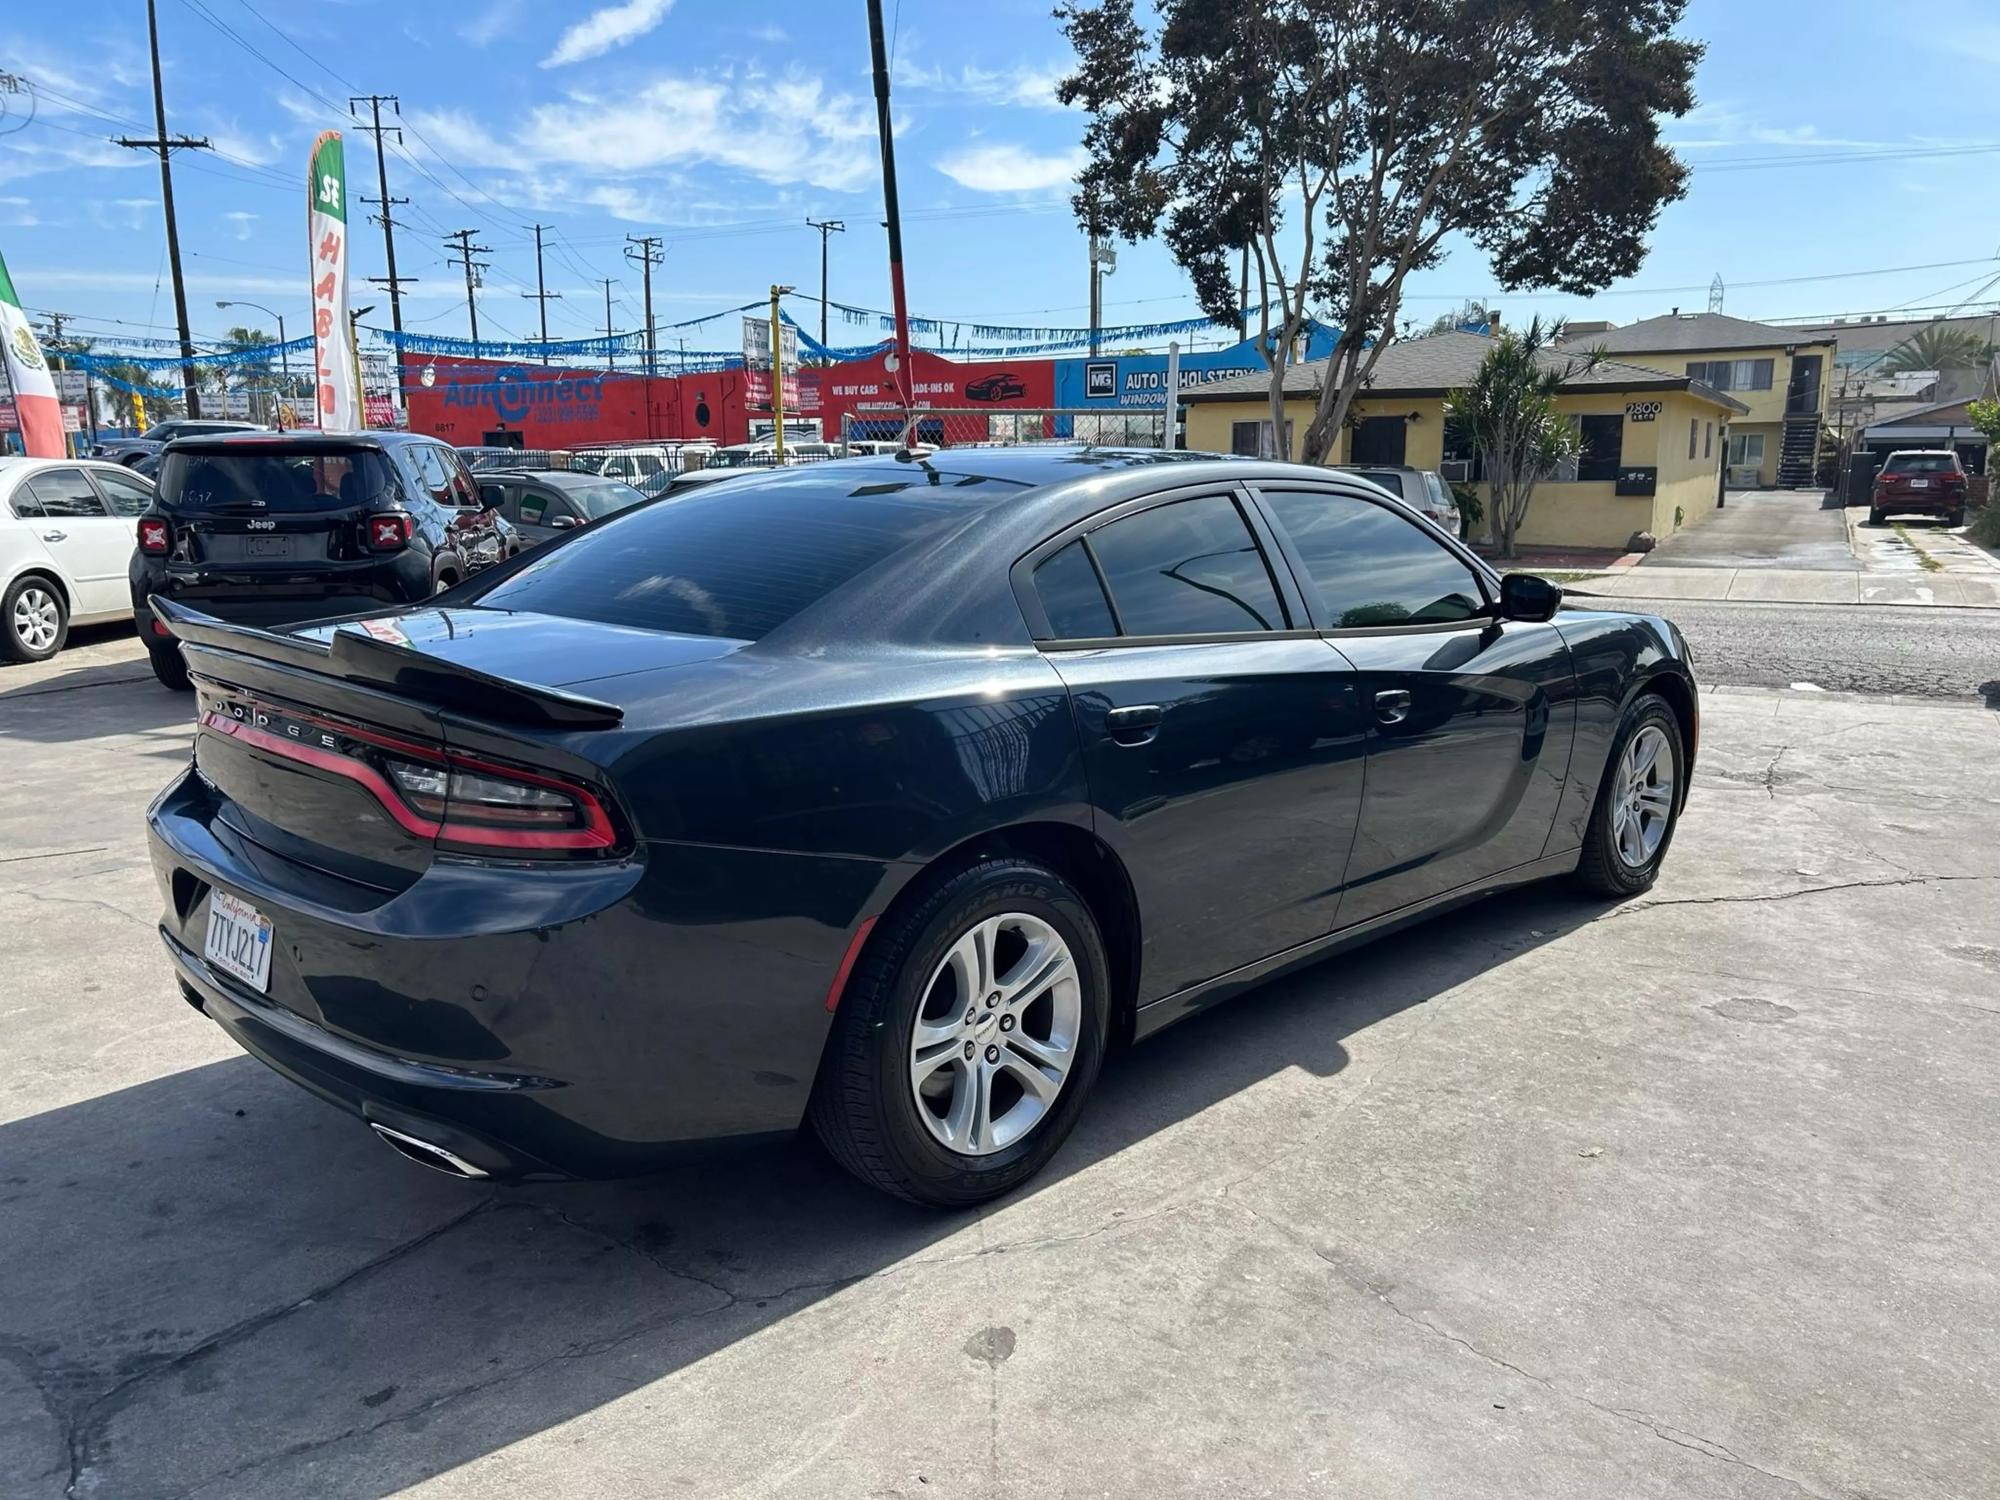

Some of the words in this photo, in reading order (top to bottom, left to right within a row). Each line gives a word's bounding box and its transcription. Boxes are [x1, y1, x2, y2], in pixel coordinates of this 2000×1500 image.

[319, 174, 340, 210] SE
[1091, 374, 1112, 387] MG
[1126, 372, 1158, 390] AUTO
[1162, 368, 1255, 389] UHOLSTERY
[832, 385, 844, 396] WE
[845, 385, 859, 395] BUY
[860, 385, 878, 395] CARS
[943, 382, 954, 393] OK
[1626, 403, 1660, 414] 2800
[247, 520, 275, 531] Jeep
[215, 701, 335, 747] DODGE
[210, 910, 267, 976] 7TYJ217
